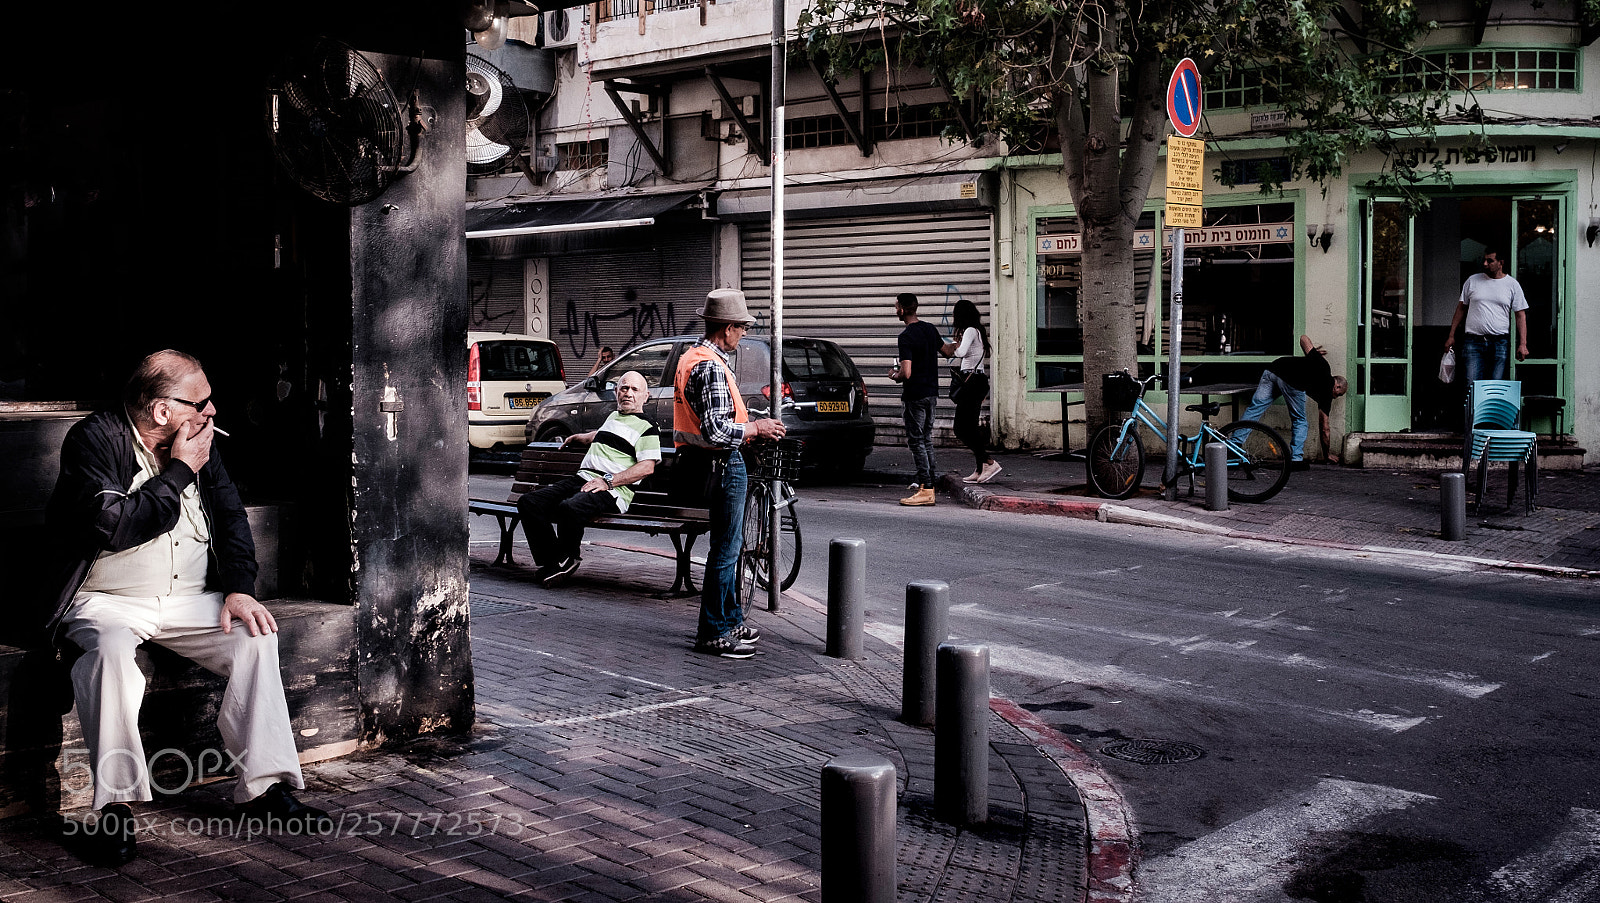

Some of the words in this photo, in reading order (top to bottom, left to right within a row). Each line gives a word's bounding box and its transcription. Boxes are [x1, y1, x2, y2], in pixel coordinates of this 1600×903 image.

[1185, 230, 1207, 244] לחם
[1212, 230, 1231, 242] בית
[1236, 228, 1270, 241] חומוס
[1056, 237, 1078, 250] לחם
[531, 260, 542, 334] YOKO
